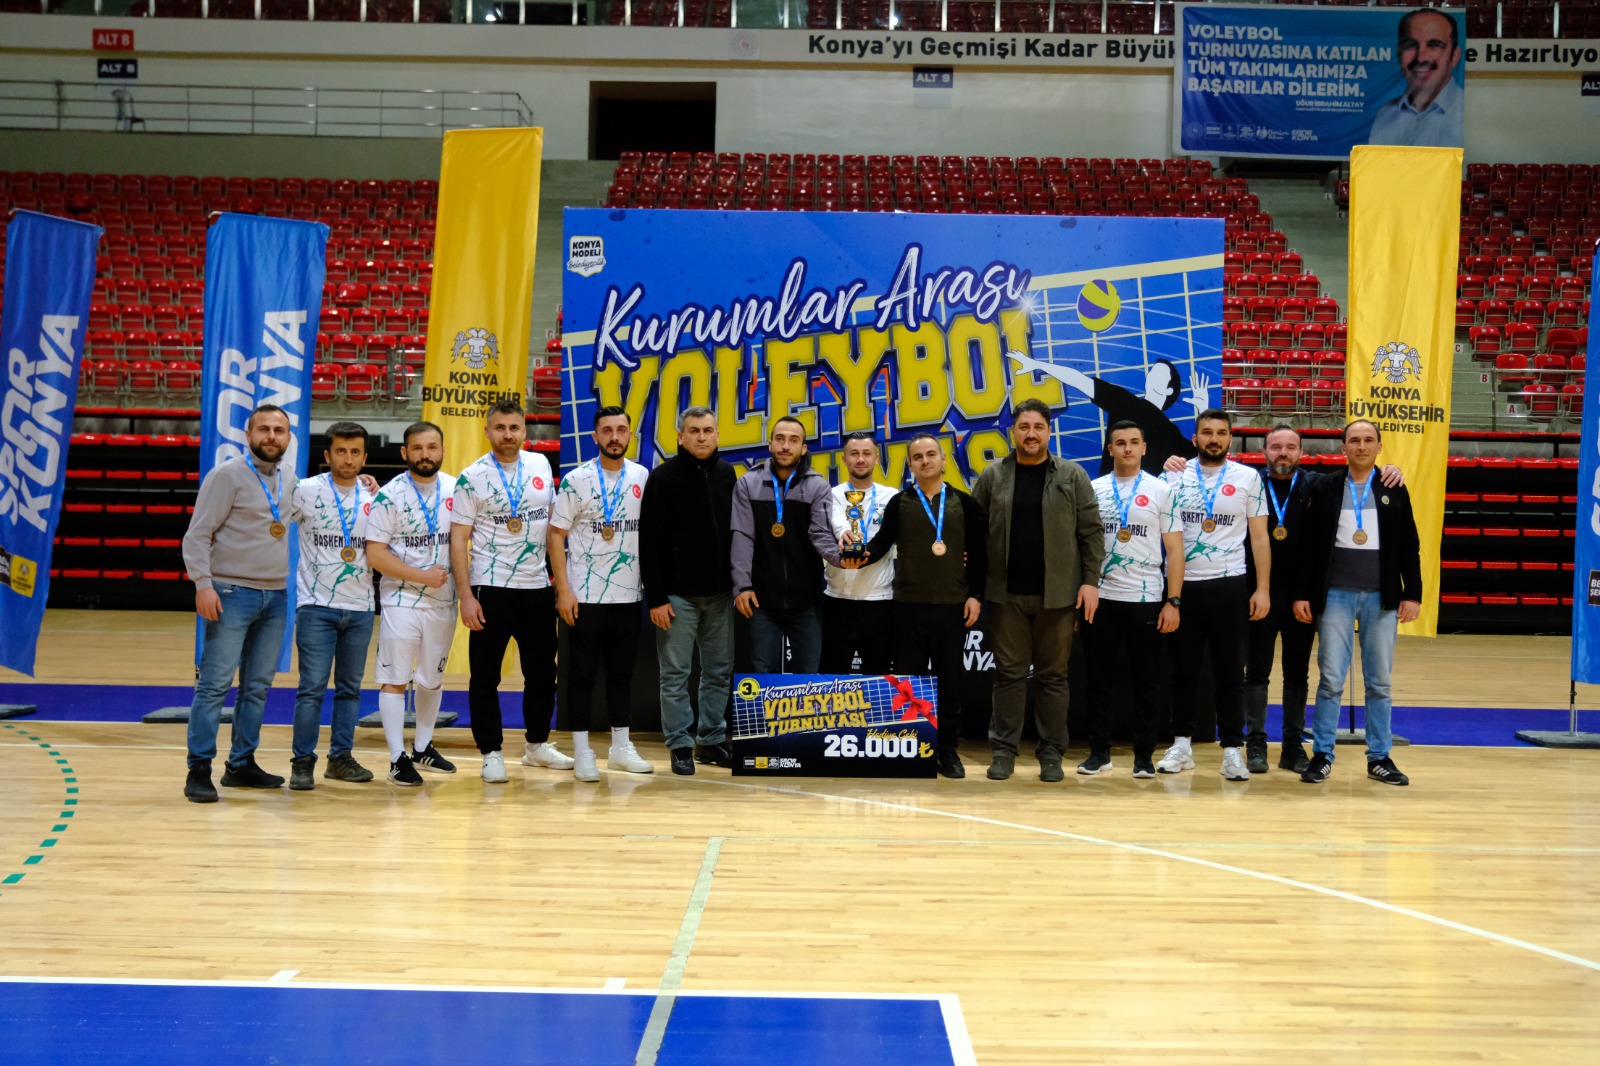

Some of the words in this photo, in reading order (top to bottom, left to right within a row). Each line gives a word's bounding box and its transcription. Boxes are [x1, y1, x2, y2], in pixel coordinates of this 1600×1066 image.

[97, 33, 118, 46] ALT
[121, 33, 130, 46] 8
[1188, 24, 1283, 41] VOLEYBOL
[808, 34, 912, 59] Konya'yı
[920, 37, 1016, 60] Geçmişi
[1025, 39, 1098, 58] Kadar
[1188, 42, 1313, 60] TURNUVASINA
[1316, 46, 1391, 61] KATILAN
[101, 64, 122, 73] ALT
[1188, 58, 1226, 75] TÜM
[1229, 62, 1368, 79] TAKIMLARIMIZA
[915, 73, 938, 83] ALT
[1188, 77, 1285, 97] BAŞARILAR
[1288, 78, 1365, 98] DİLERİM.
[572, 240, 601, 250] KONYA
[596, 260, 864, 369] Kurumlar
[876, 246, 1032, 328] Arası
[449, 371, 499, 386] KONYA
[594, 307, 1067, 461] VOLEYBOL
[422, 383, 521, 407] BÜYÜKŞEHİR
[1370, 386, 1421, 401] KONYA
[441, 406, 487, 418] BELEDİY
[15, 314, 80, 533] KONYA
[1373, 421, 1425, 434] ELEDİYESİ
[1210, 513, 1236, 526] ARBLE
[405, 533, 436, 550] BAŞKENT
[742, 682, 757, 696] 3.
[763, 681, 826, 701] Kurumlar
[828, 678, 862, 694] Arası
[763, 689, 872, 720] VOLEYBOL
[767, 711, 868, 738] TURNUVASI
